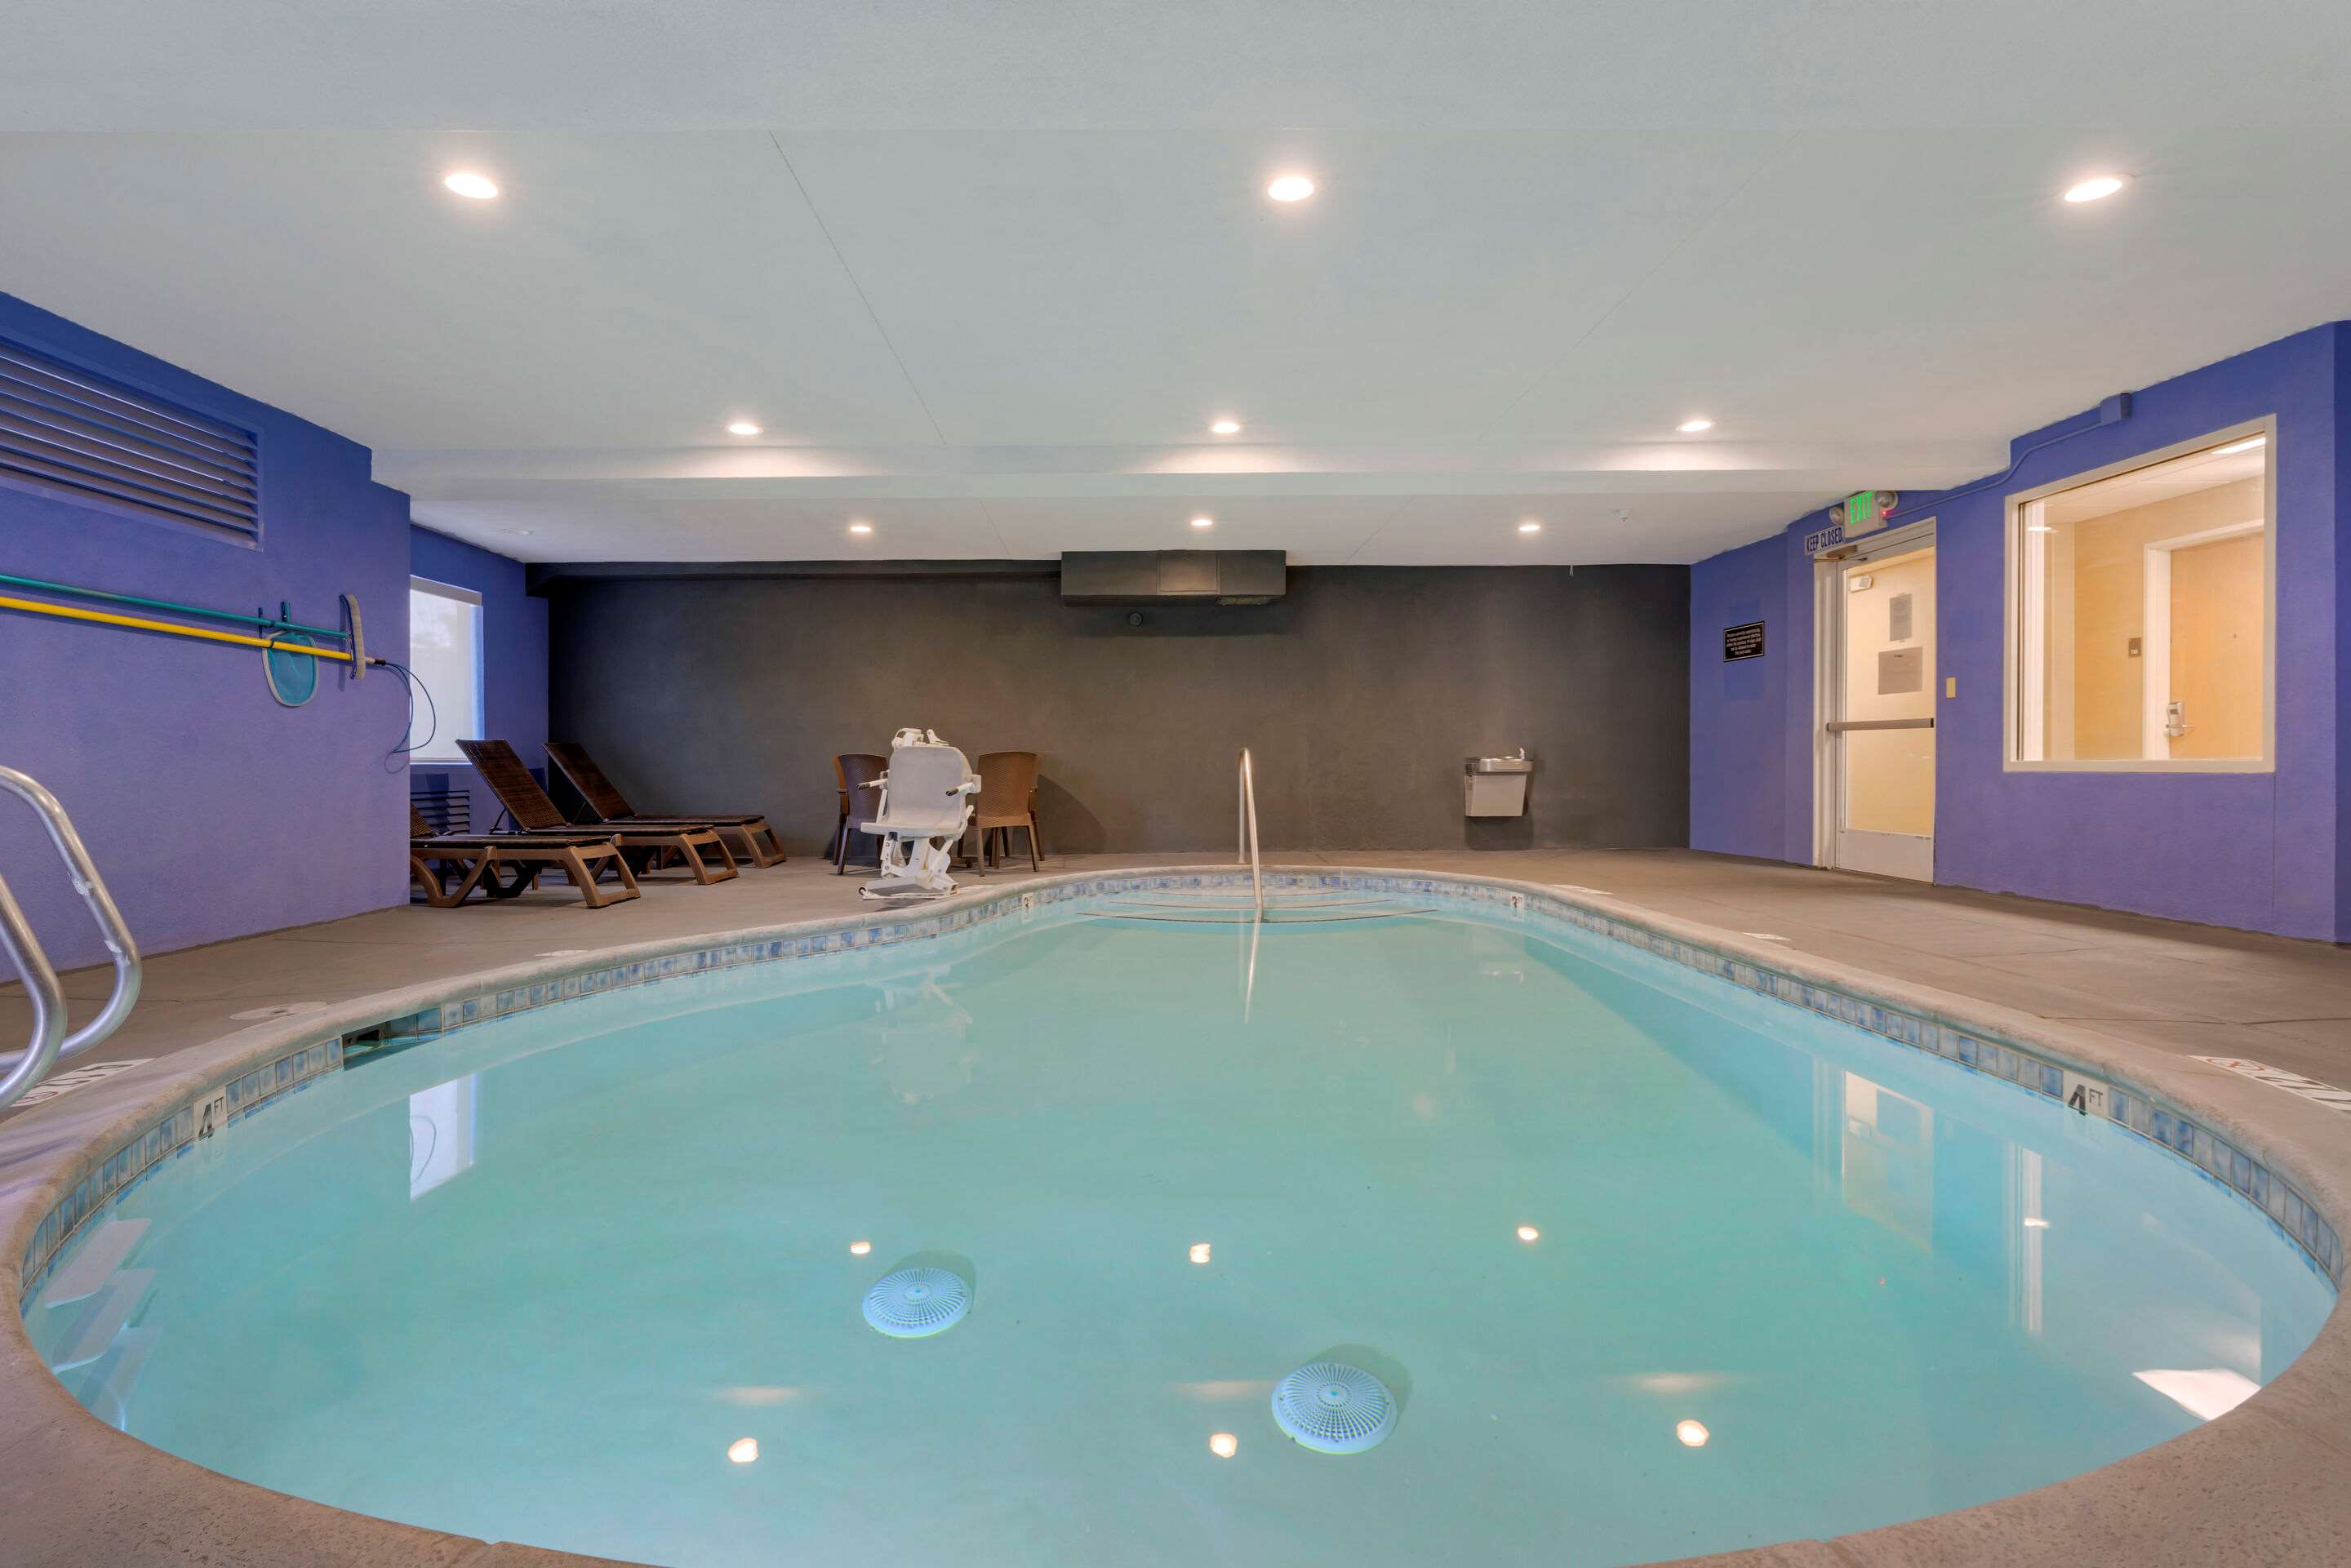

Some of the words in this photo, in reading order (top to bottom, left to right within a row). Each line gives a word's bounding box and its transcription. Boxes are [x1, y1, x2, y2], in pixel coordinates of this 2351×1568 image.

[1850, 491, 1873, 523] EXIT
[1807, 534, 1820, 553] KEEP
[1820, 527, 1842, 549] CLOSED
